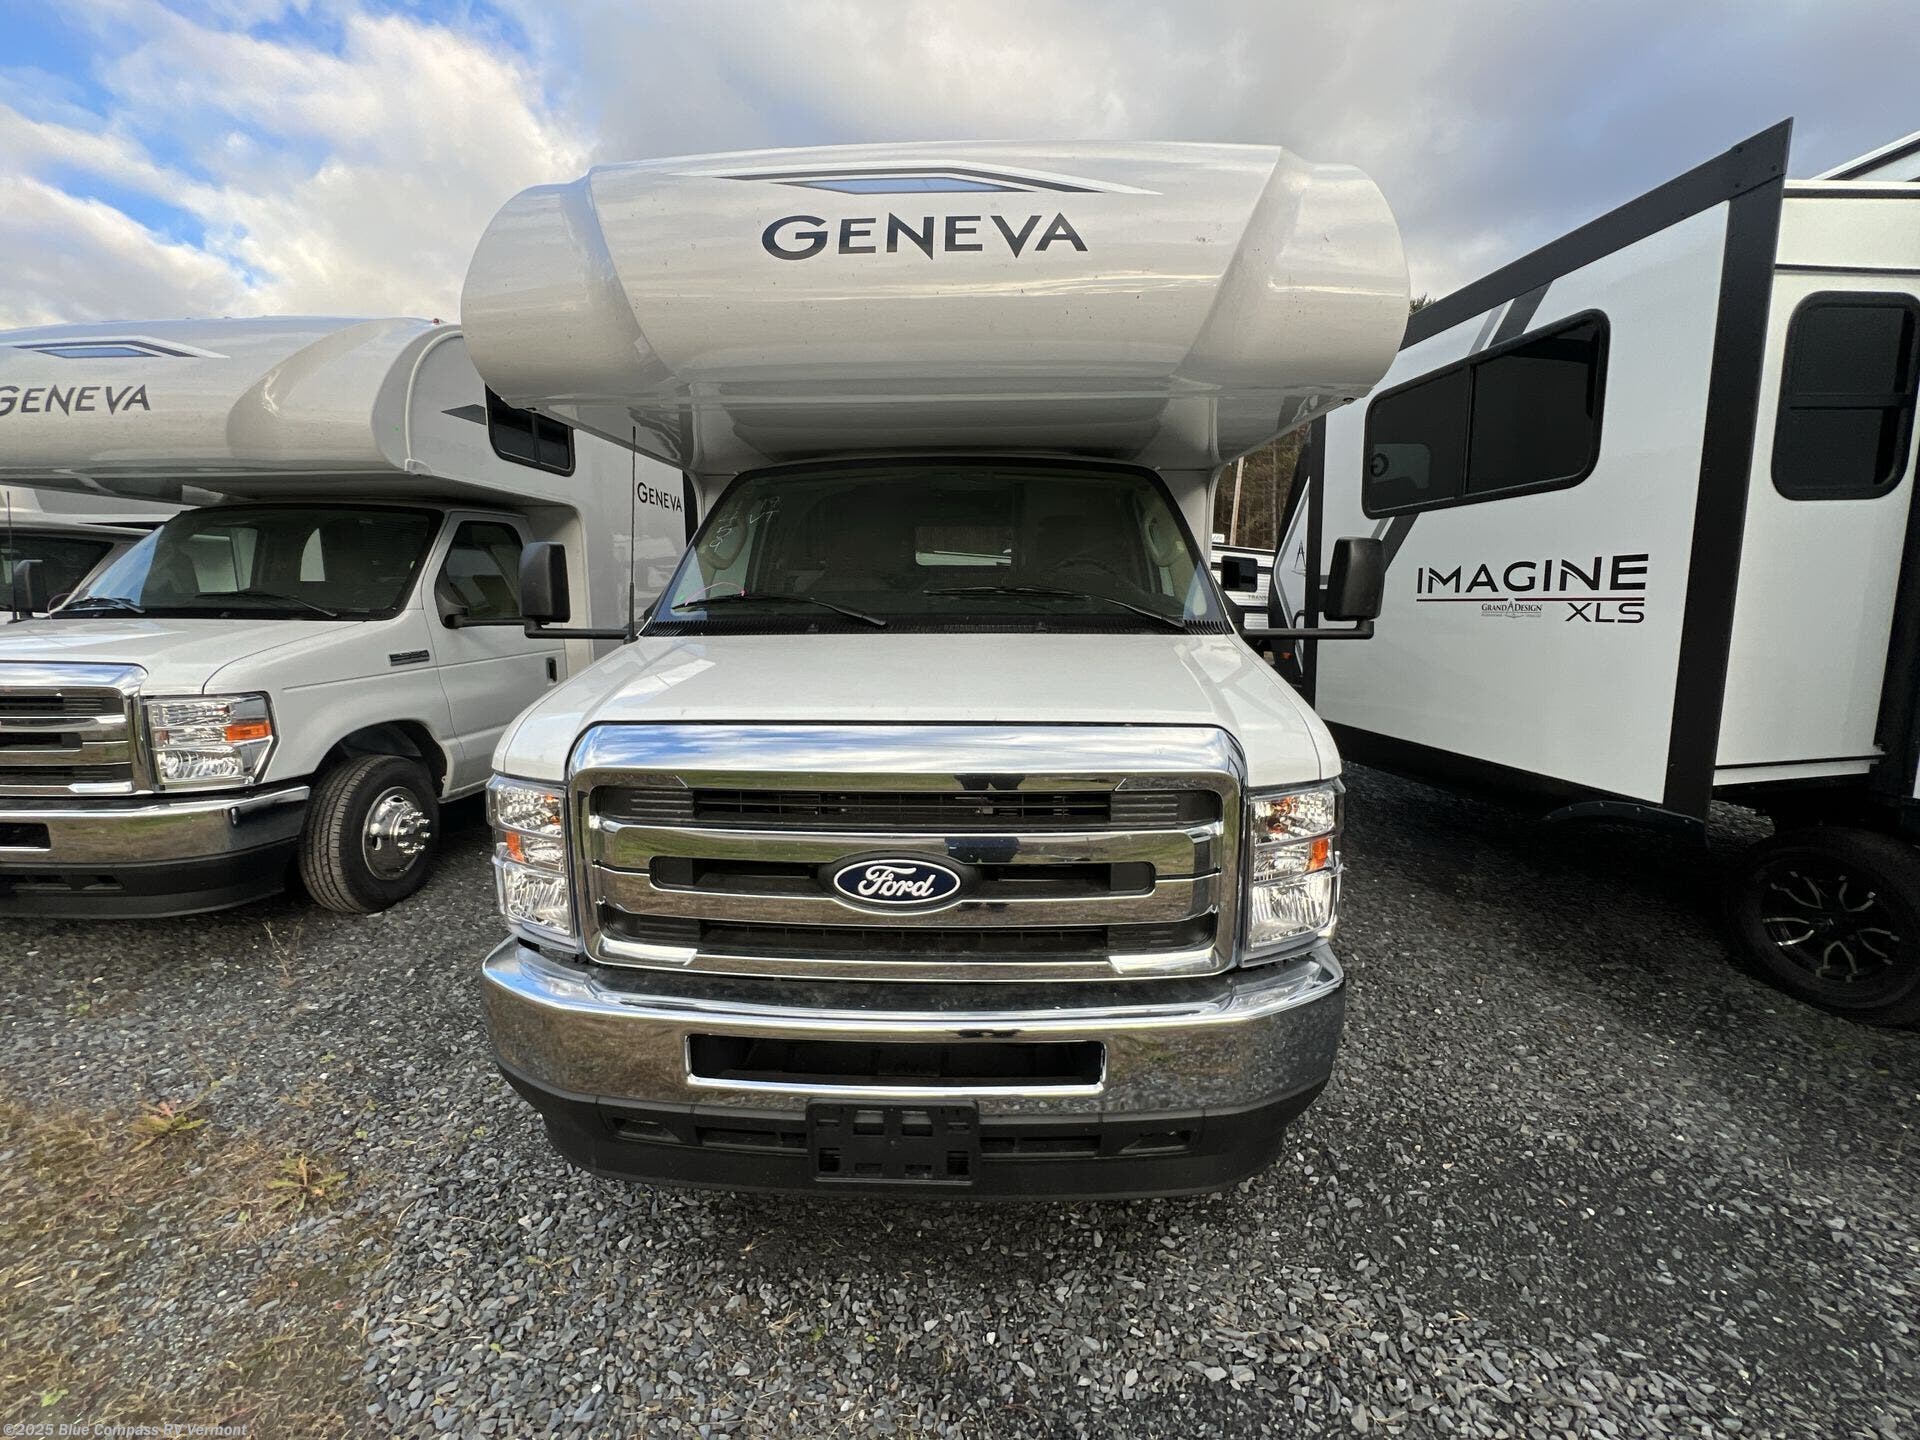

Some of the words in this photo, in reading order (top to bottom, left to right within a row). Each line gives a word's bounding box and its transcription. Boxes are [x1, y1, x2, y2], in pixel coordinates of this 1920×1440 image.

[761, 212, 1089, 261] GENEVA
[637, 481, 683, 512] GENEVA
[1416, 553, 1649, 594] IMAGINE
[1481, 603, 1508, 612] GRAND
[1514, 603, 1542, 612] DESIGN
[1564, 602, 1645, 624] XLS
[857, 865, 936, 897] Ford
